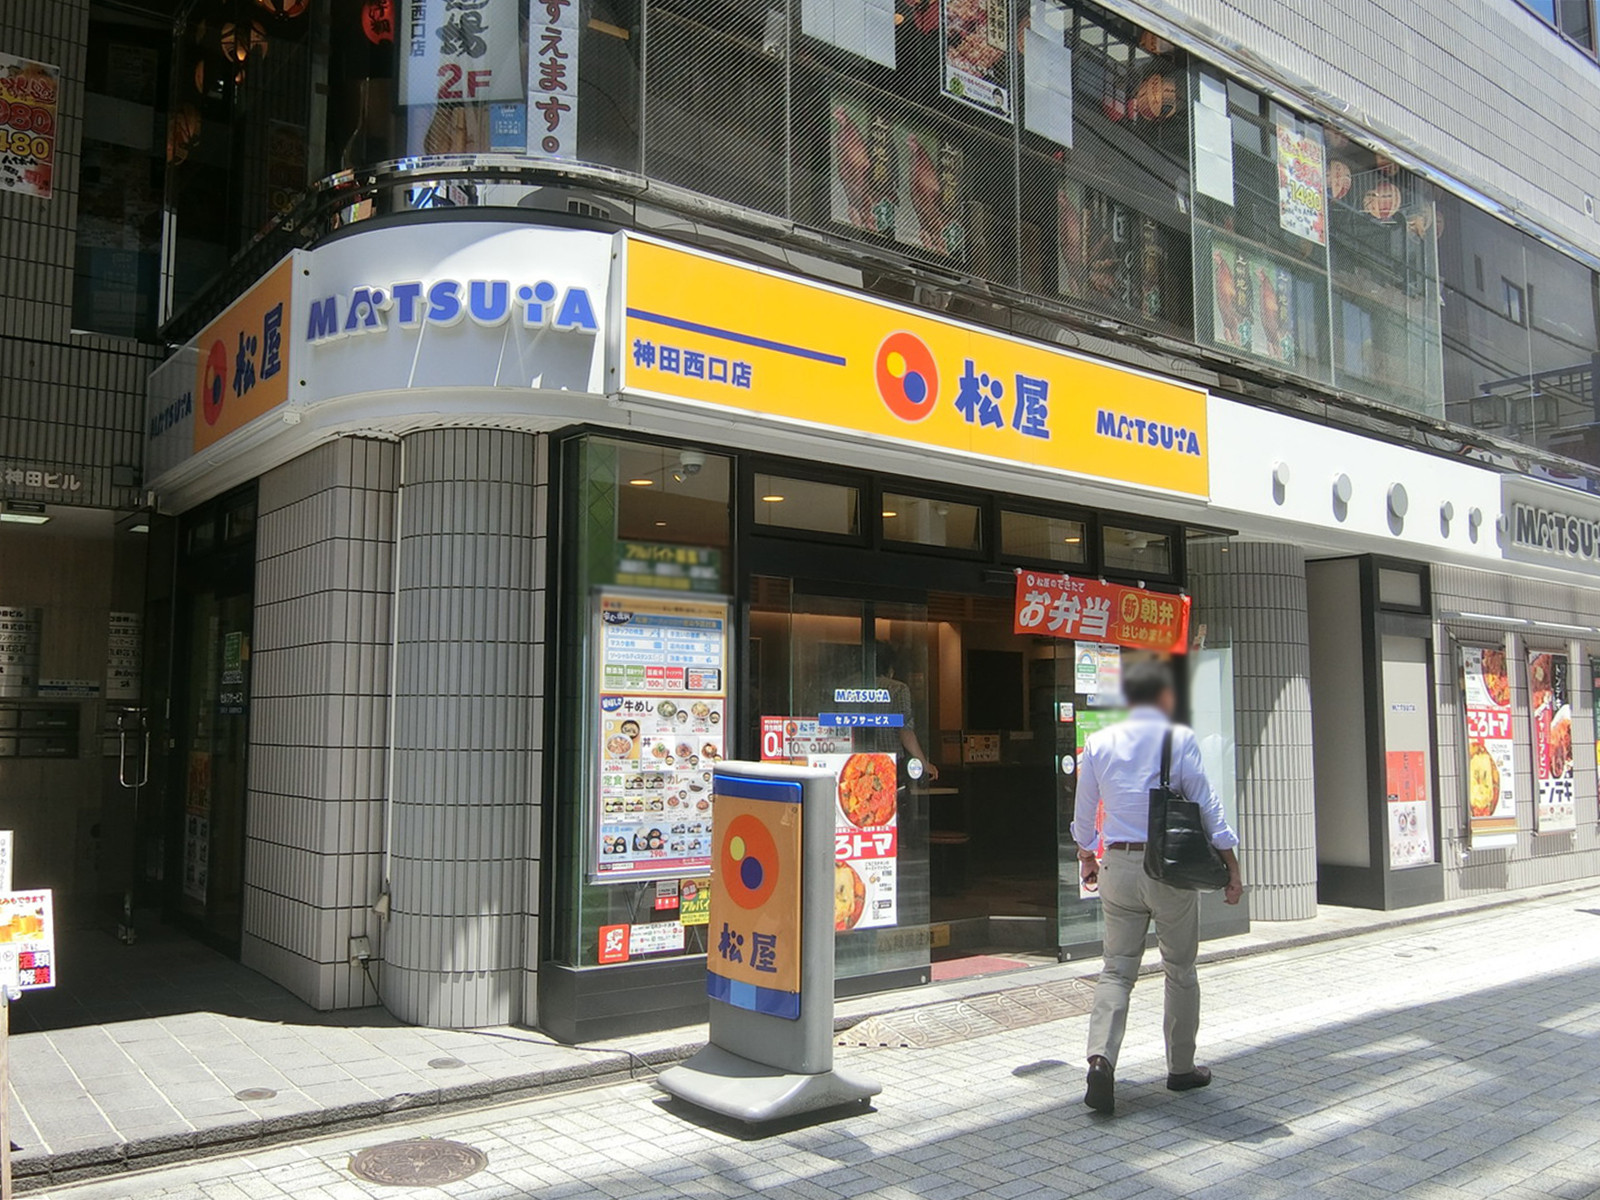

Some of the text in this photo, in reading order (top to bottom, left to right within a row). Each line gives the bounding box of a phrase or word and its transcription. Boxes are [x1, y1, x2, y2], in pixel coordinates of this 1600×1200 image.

[410, 0, 427, 57] 西口店
[437, 63, 492, 99] 2F
[306, 280, 600, 344] MATSUYA
[233, 302, 283, 398] 松屋
[632, 339, 752, 389] 神田西口店
[954, 359, 1051, 440] 松屋
[1096, 410, 1201, 457] MATSUYA
[0, 469, 81, 491] 神田ビル
[1512, 502, 1600, 561] MATSU
[1019, 590, 1111, 637] お弁当
[1122, 595, 1174, 626] 新 朝弁
[624, 700, 654, 713] 牛めし
[834, 688, 891, 703] MATSUYA
[835, 715, 890, 726] セルフサービス
[1467, 711, 1508, 737] ごろトマ
[667, 774, 689, 786] カレー
[835, 832, 893, 860] ろトマ
[718, 922, 776, 972] 松屋
